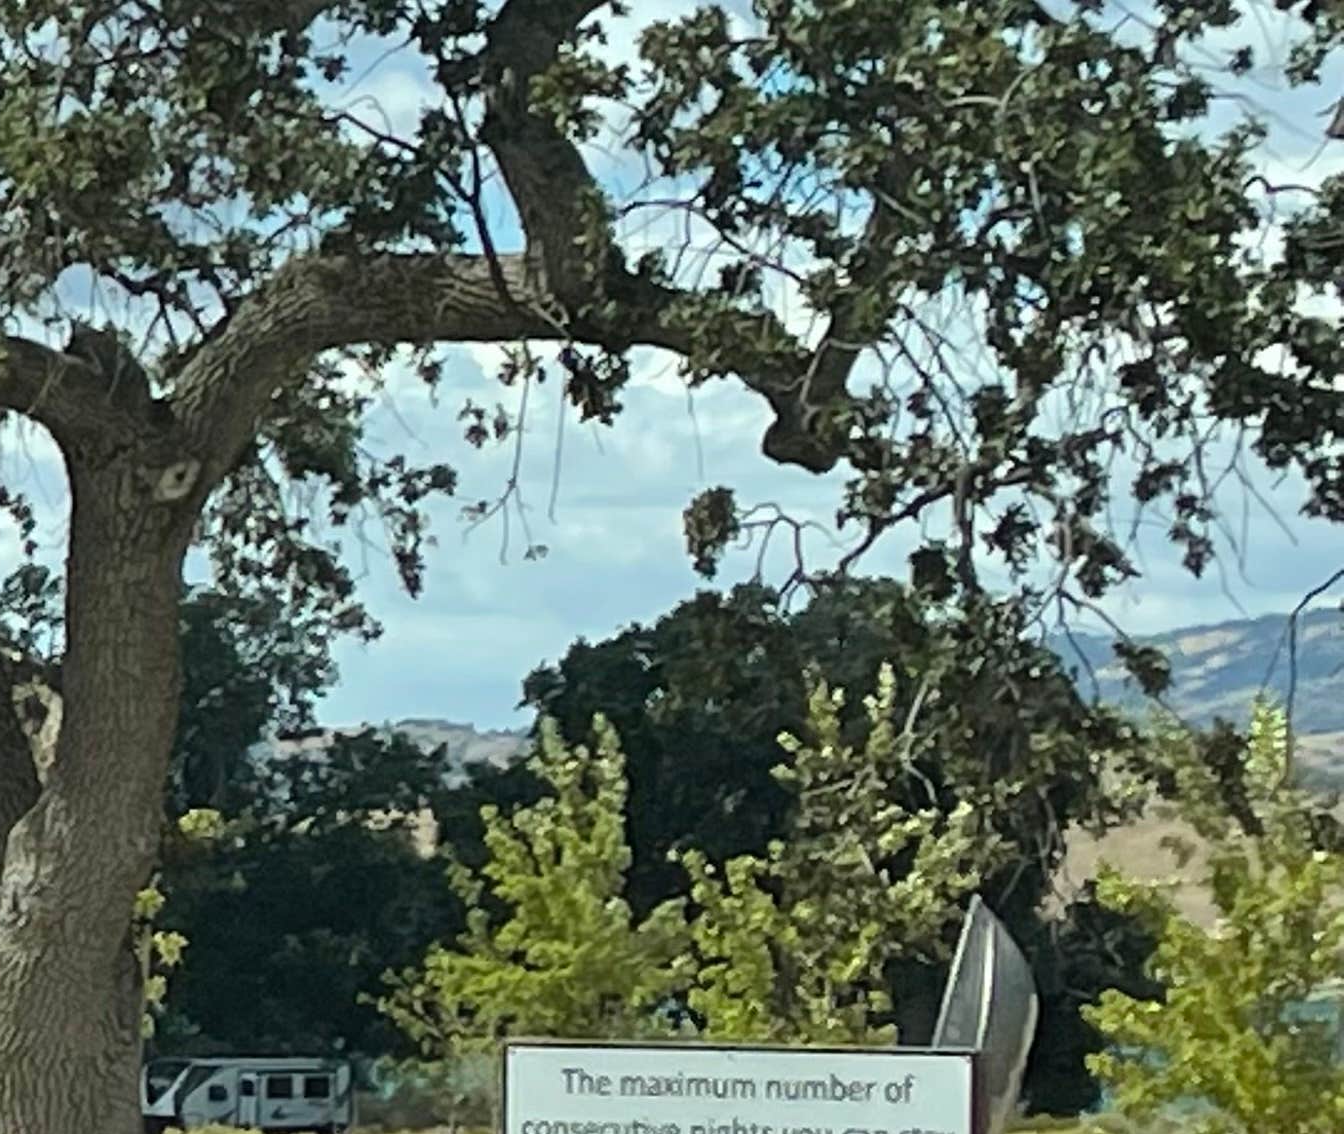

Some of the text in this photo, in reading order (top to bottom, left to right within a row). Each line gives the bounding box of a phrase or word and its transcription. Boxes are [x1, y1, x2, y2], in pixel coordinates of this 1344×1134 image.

[562, 1067, 916, 1103] The maximum number of
